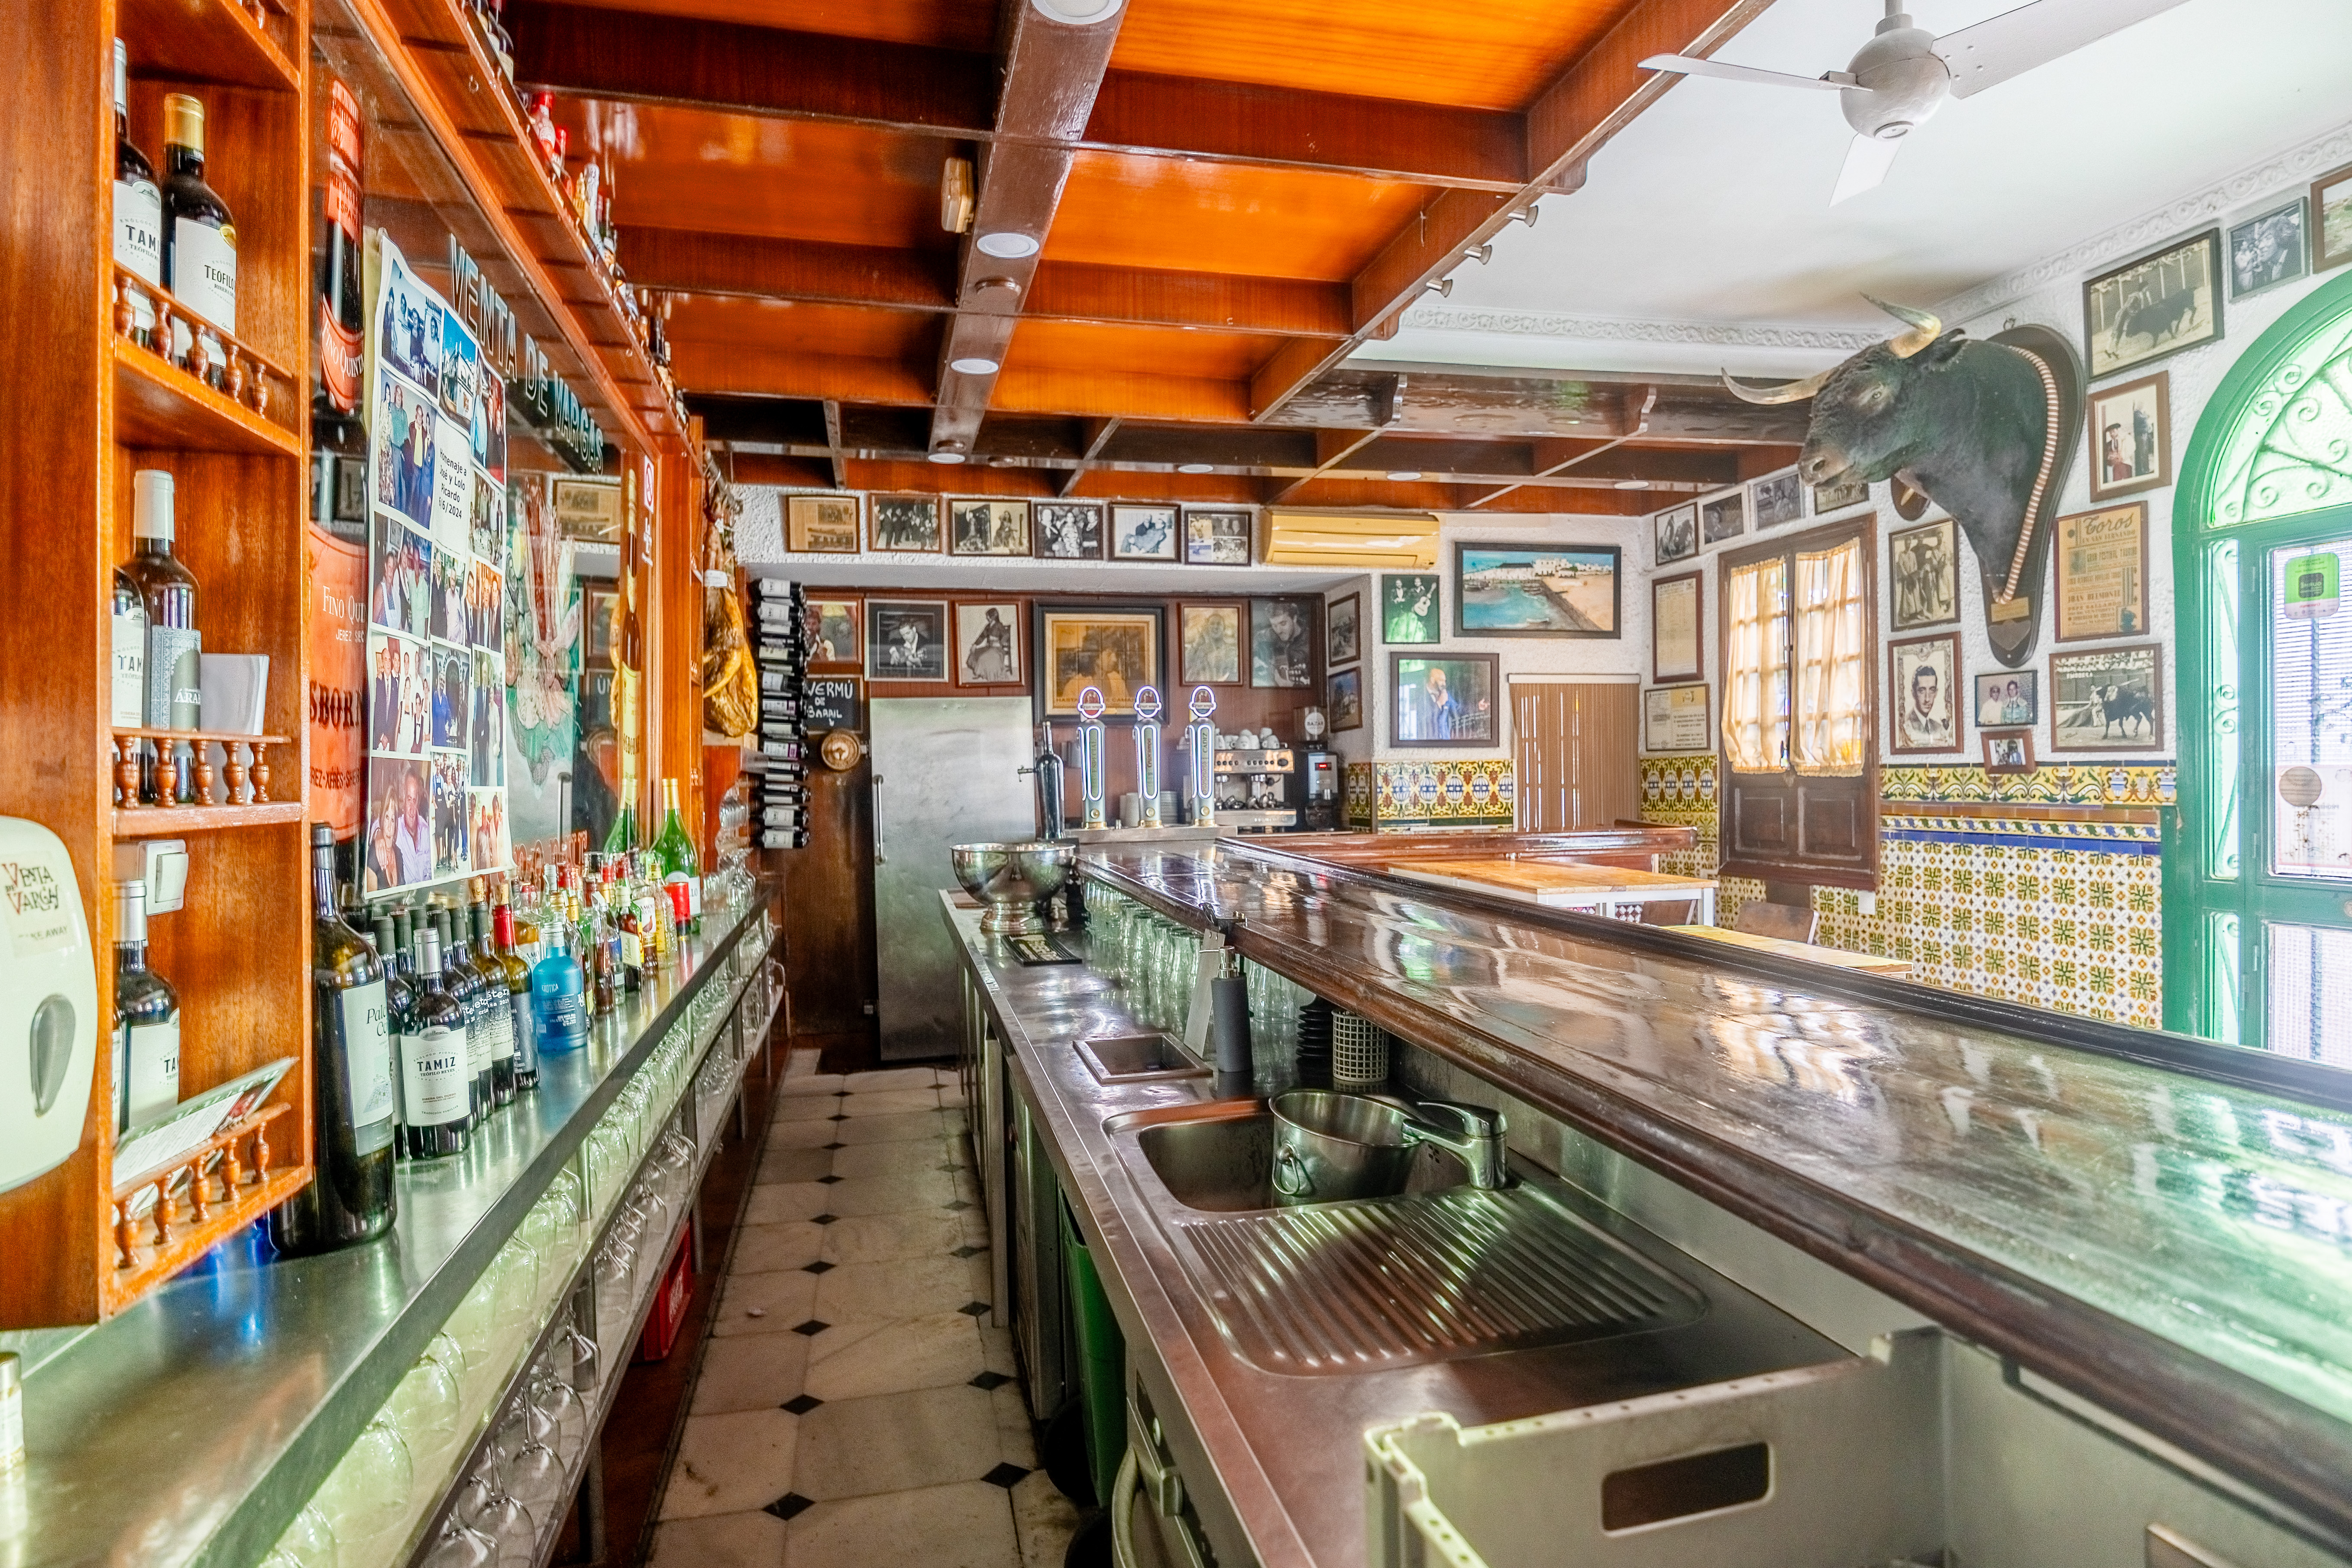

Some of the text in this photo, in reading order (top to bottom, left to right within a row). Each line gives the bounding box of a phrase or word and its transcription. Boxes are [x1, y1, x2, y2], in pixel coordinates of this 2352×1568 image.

[450, 233, 518, 384] VENTA
[525, 333, 548, 417] DE
[553, 370, 604, 476] VARGAS
[440, 448, 463, 473] Homenaje
[449, 475, 453, 485] y
[455, 476, 465, 490] Lolo
[441, 483, 460, 502] Picardo
[439, 497, 462, 519] 6/6/2024
[2083, 513, 2134, 535] Toros
[323, 585, 344, 618] FINO
[336, 629, 352, 642] JEREZ
[807, 679, 853, 699] VERMÚ
[541, 983, 559, 993] EXOTICA
[414, 1052, 436, 1062] ENÓLOGO
[417, 1057, 456, 1072] TAMIZ
[443, 1105, 459, 1113] FAMILIAR
